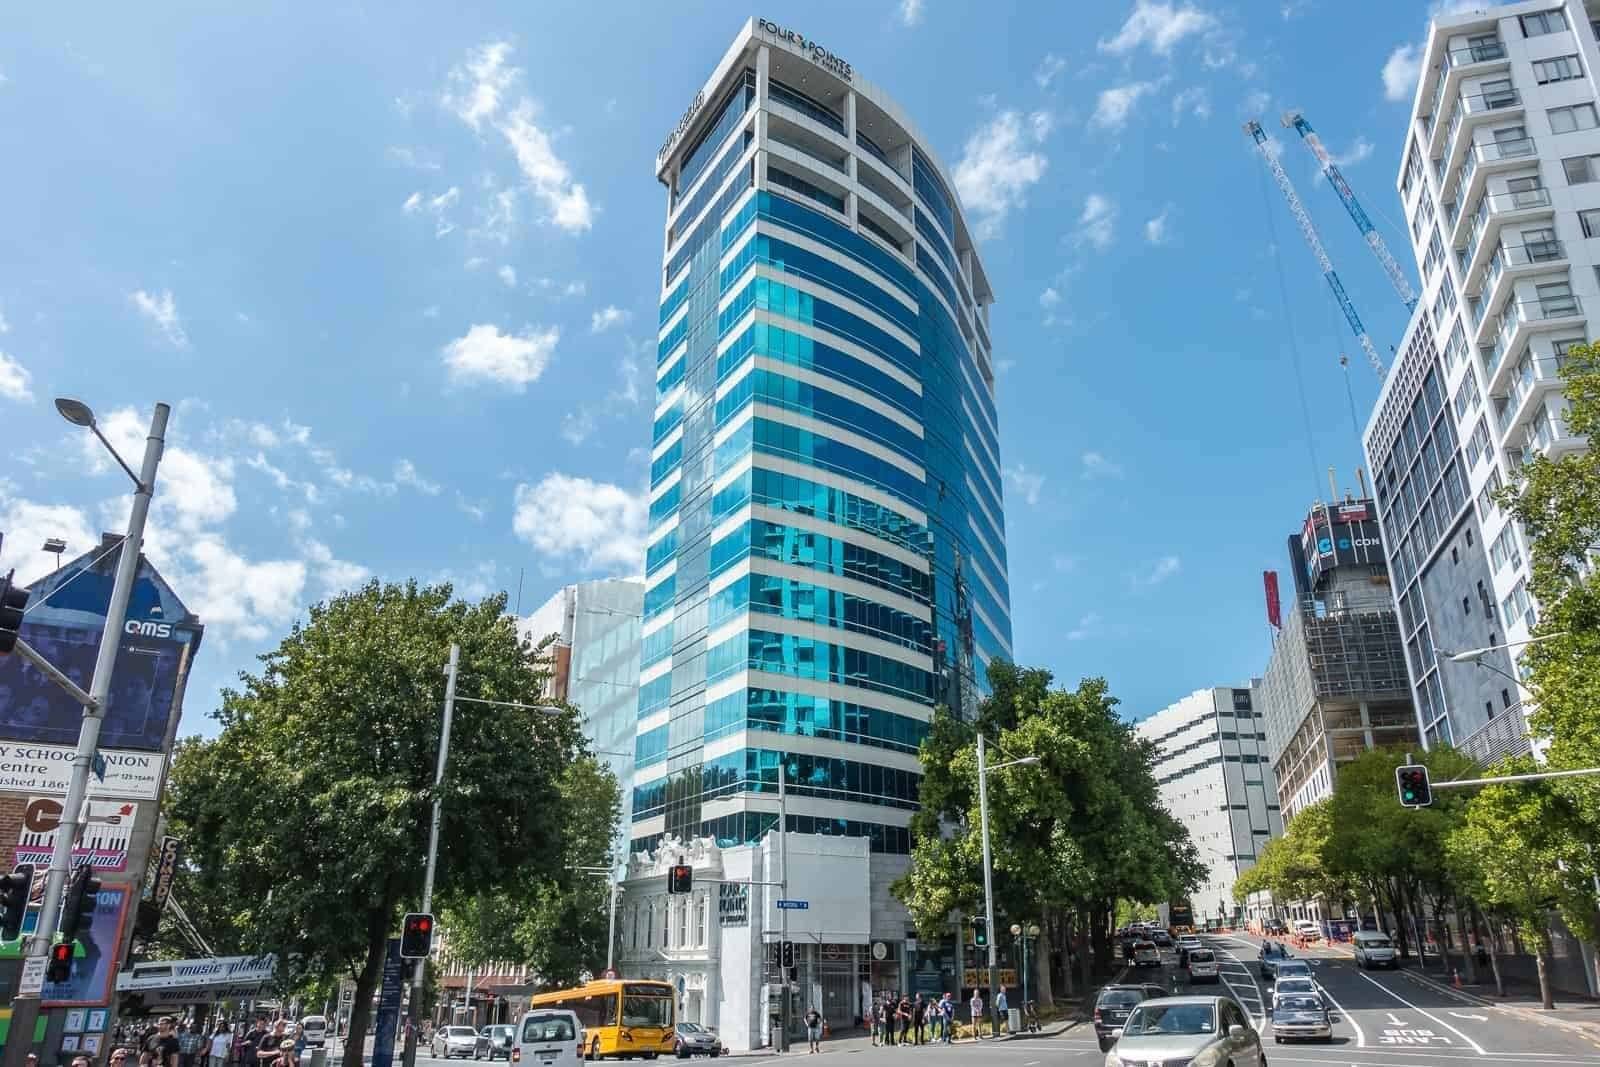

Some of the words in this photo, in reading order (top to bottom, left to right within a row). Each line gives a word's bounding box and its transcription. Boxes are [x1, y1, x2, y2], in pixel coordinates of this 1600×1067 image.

[759, 18, 796, 43] FOUR
[809, 41, 851, 74] POINTS
[14, 748, 77, 763] SCHOO
[106, 755, 150, 768] NION
[0, 762, 48, 775] entre
[0, 775, 36, 788] ished
[41, 780, 70, 790] 186
[18, 852, 53, 864] mus
[73, 849, 127, 869] planet
[178, 963, 222, 976] music
[228, 956, 273, 975] planet
[161, 989, 208, 999] music
[215, 983, 262, 999] planet
